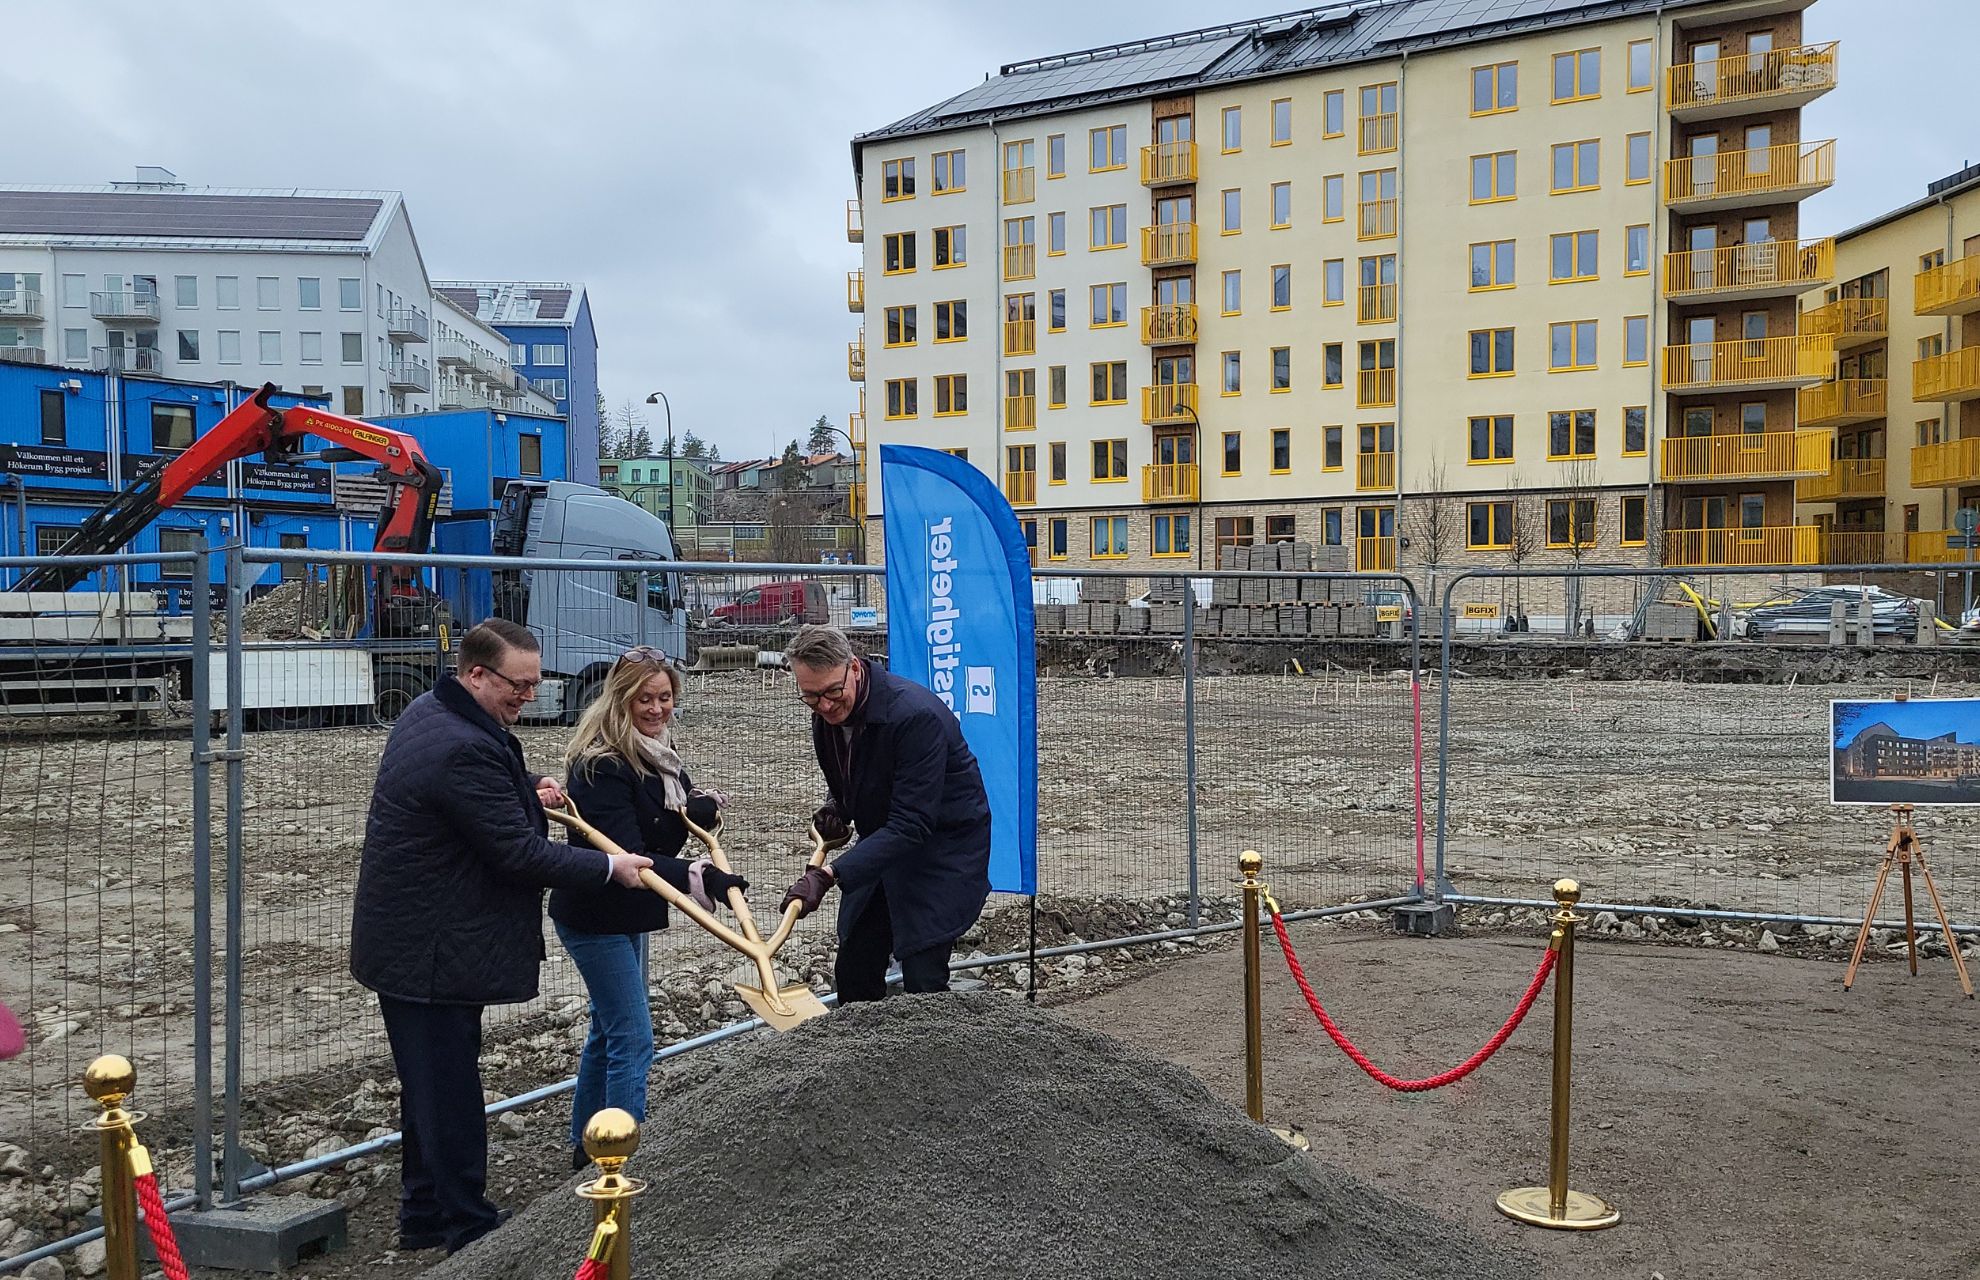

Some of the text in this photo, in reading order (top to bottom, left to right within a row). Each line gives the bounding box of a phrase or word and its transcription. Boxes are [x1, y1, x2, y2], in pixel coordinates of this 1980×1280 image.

[354, 430, 388, 444] PALFINGER
[16, 451, 61, 462] Välkommen
[62, 455, 73, 463] till
[7, 461, 93, 475] Hökerum Bygg projekt!
